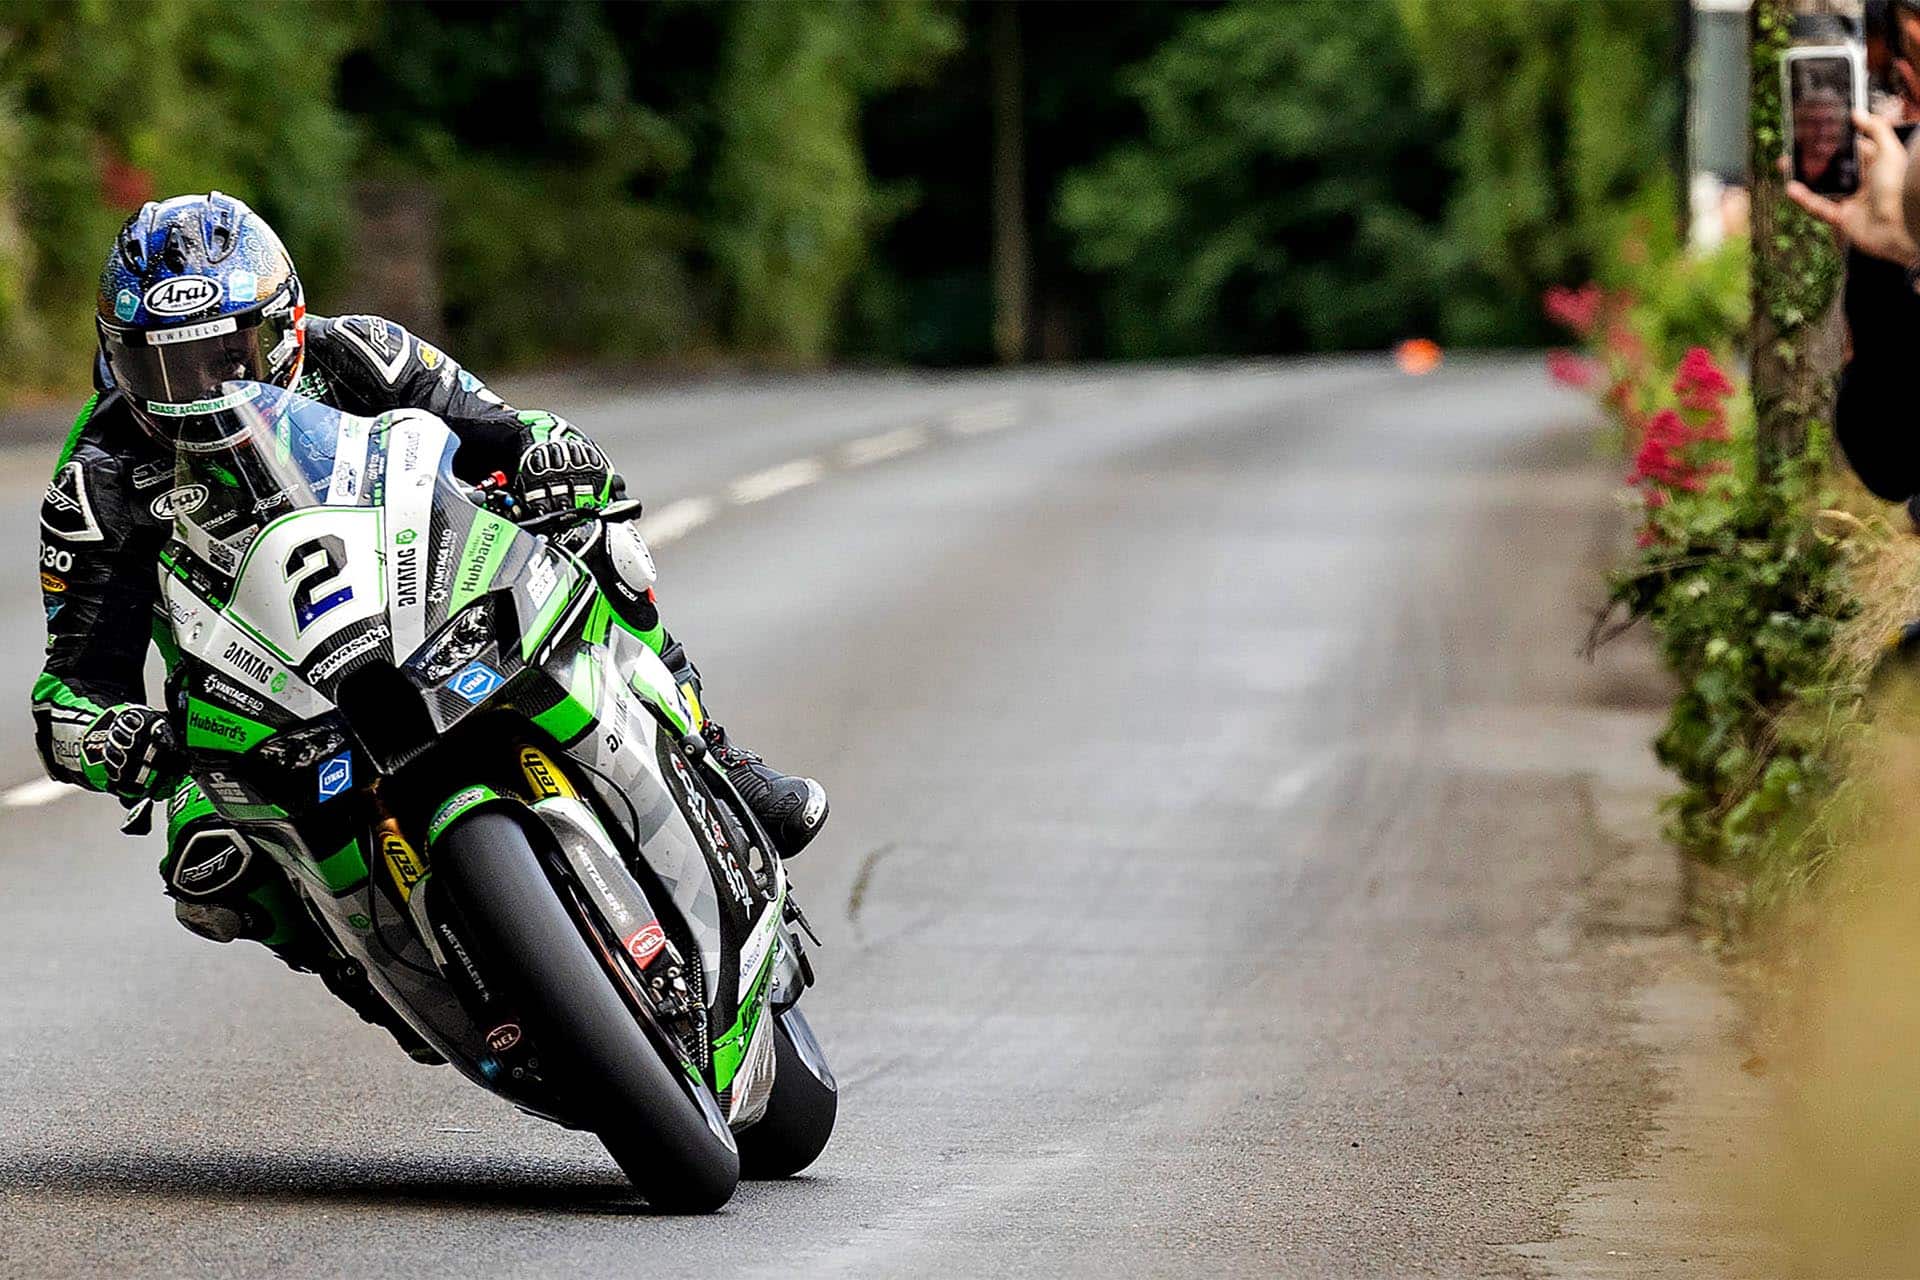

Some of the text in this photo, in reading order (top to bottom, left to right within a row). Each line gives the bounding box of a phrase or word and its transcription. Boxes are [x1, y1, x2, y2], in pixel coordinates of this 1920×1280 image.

[153, 281, 208, 306] Arai
[179, 399, 225, 415] ACCIDENT
[397, 548, 417, 607] DATATAG
[461, 522, 500, 592] Hubbard's
[284, 535, 354, 635] 2
[223, 641, 274, 684] DATATAG
[307, 625, 390, 685] Kawasaki
[190, 712, 247, 742] Hubbard's
[180, 844, 237, 884] RST
[440, 924, 486, 990] METZELER
